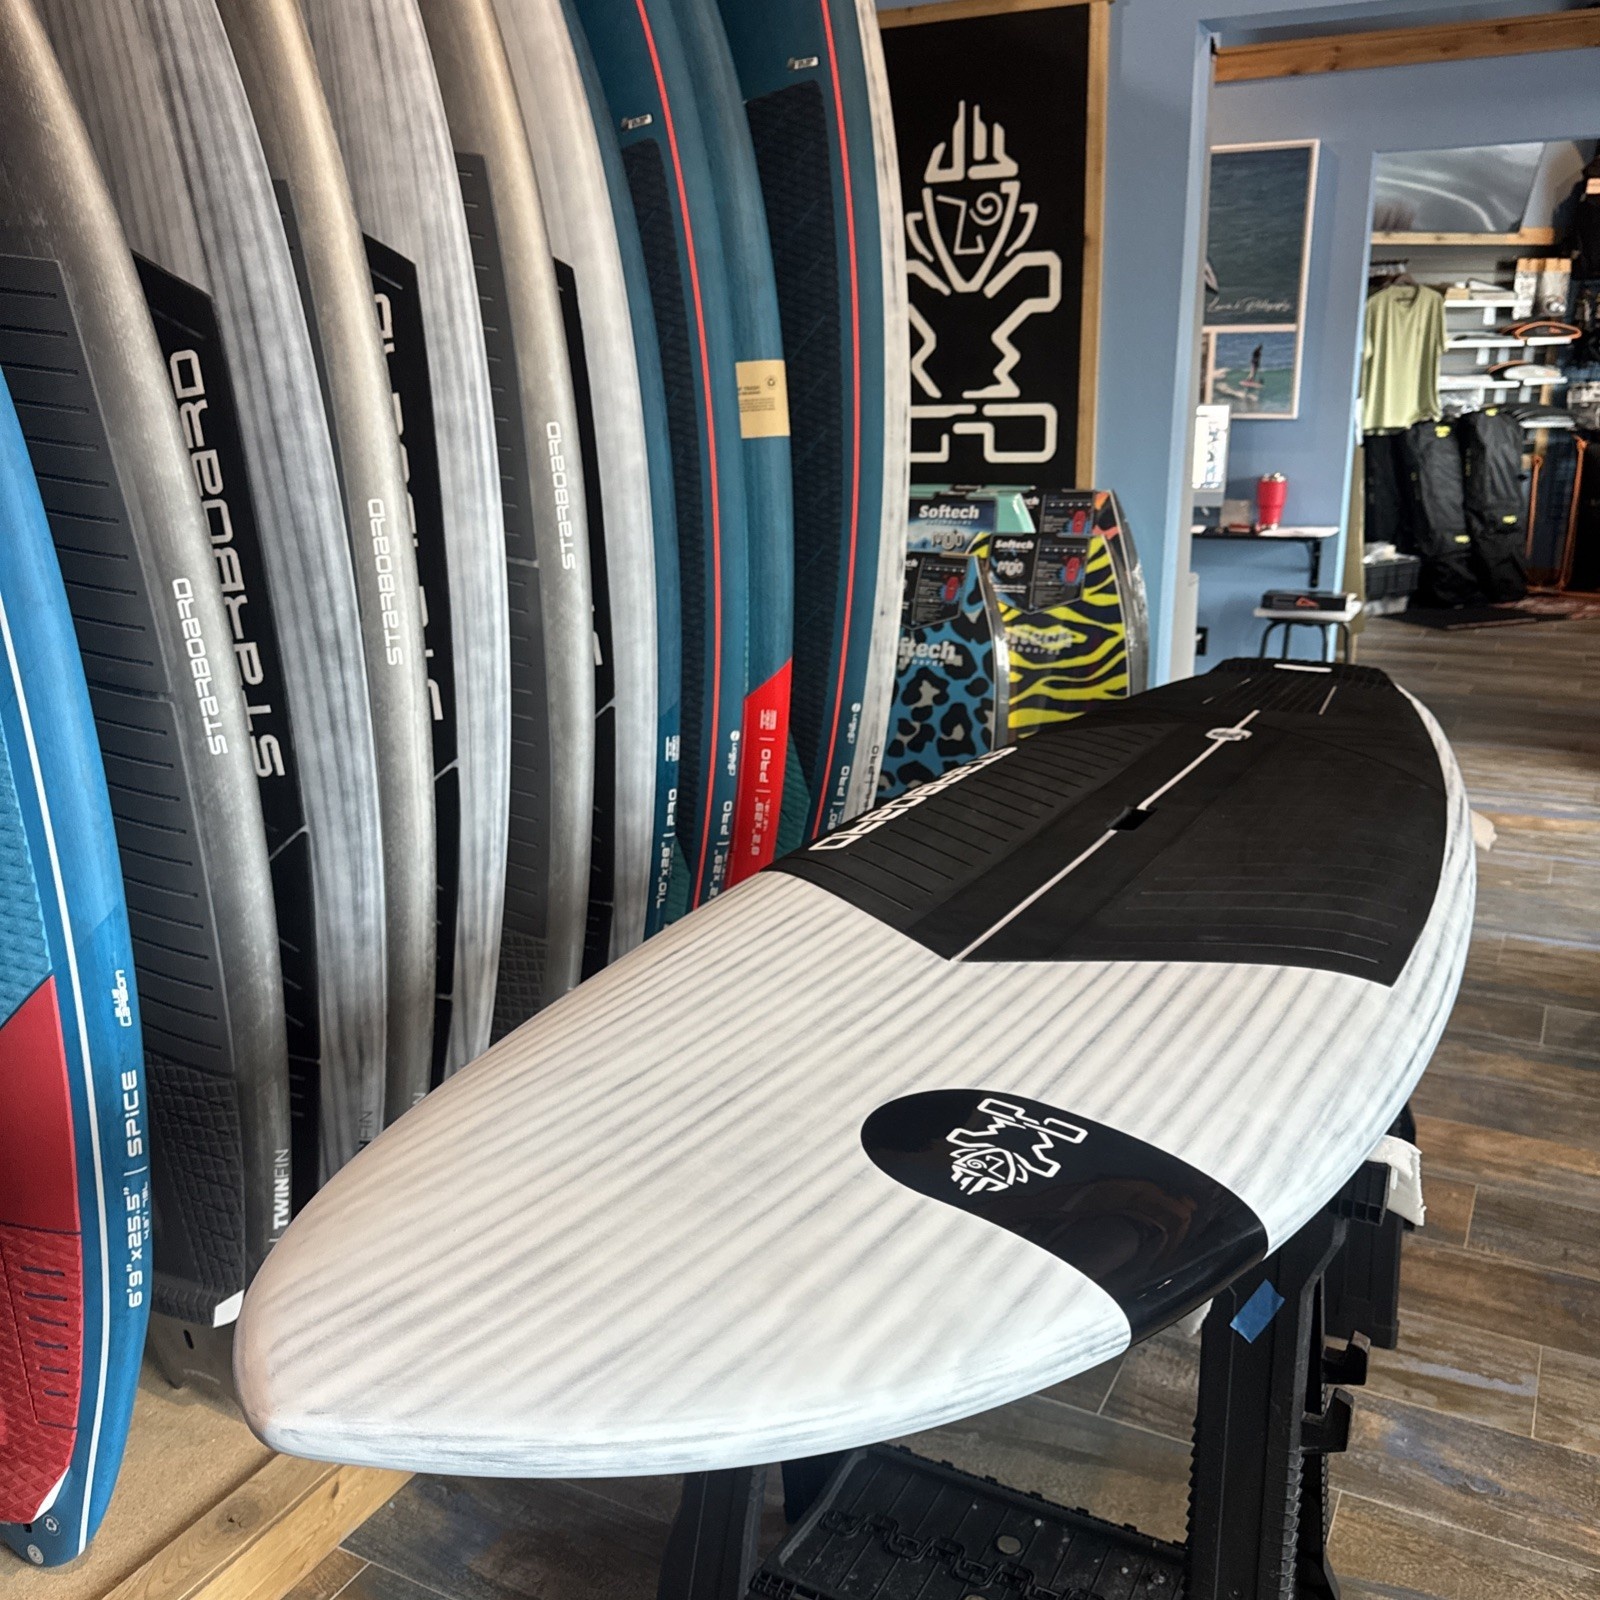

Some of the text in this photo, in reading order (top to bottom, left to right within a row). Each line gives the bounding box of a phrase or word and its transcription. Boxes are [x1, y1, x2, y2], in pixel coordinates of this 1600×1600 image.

[547, 421, 577, 570] STARBOARD
[918, 503, 980, 519] Softech
[367, 498, 403, 666] STARBOARD
[172, 577, 228, 756] STARBOARD
[899, 636, 956, 660] ftech
[759, 748, 771, 783] PRO
[836, 765, 851, 797] PRO
[666, 788, 677, 827] PRO
[720, 801, 733, 835] PRO
[273, 1148, 290, 1230] TWINFIN
